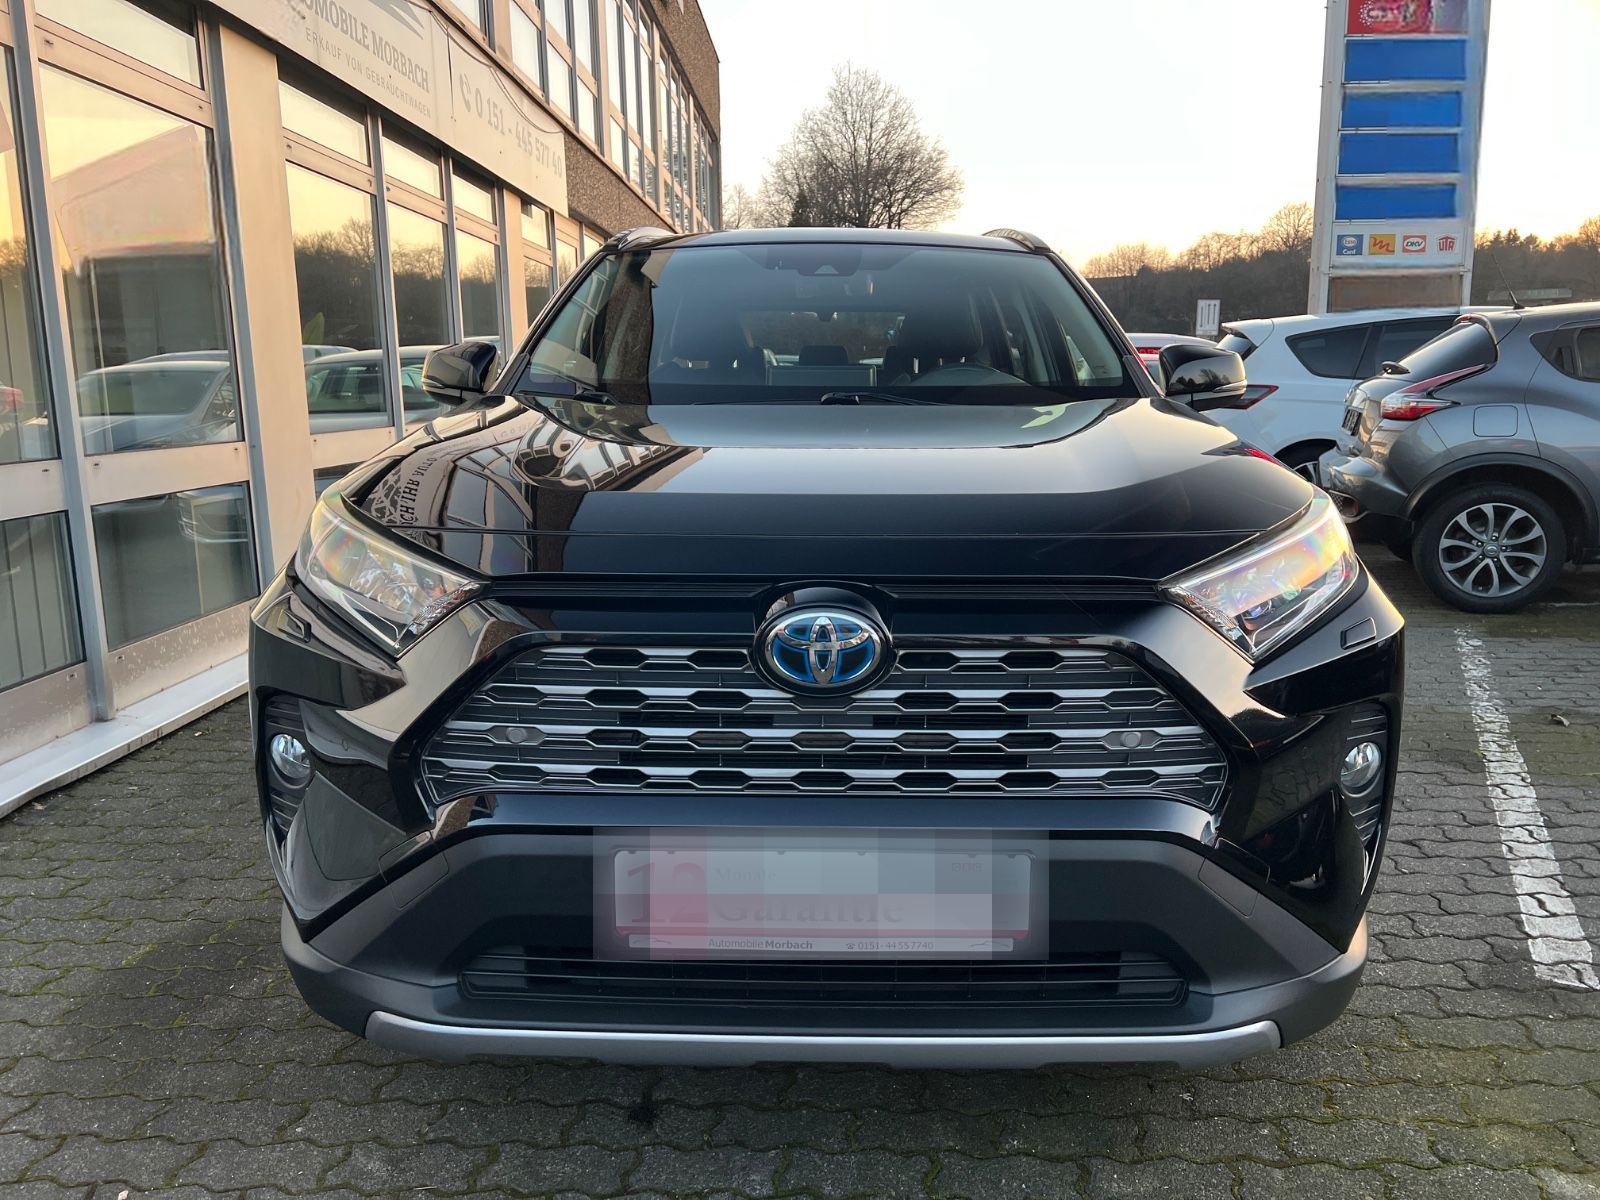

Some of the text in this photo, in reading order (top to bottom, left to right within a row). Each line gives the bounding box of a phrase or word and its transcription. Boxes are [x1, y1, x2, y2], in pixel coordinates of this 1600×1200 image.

[345, 52, 363, 75] VON
[365, 66, 431, 118] GEBRAUCHTWAGEN
[371, 30, 430, 93] MORBACH
[627, 862, 710, 923] 12
[714, 868, 776, 881] Monate
[713, 892, 904, 923] Garantie
